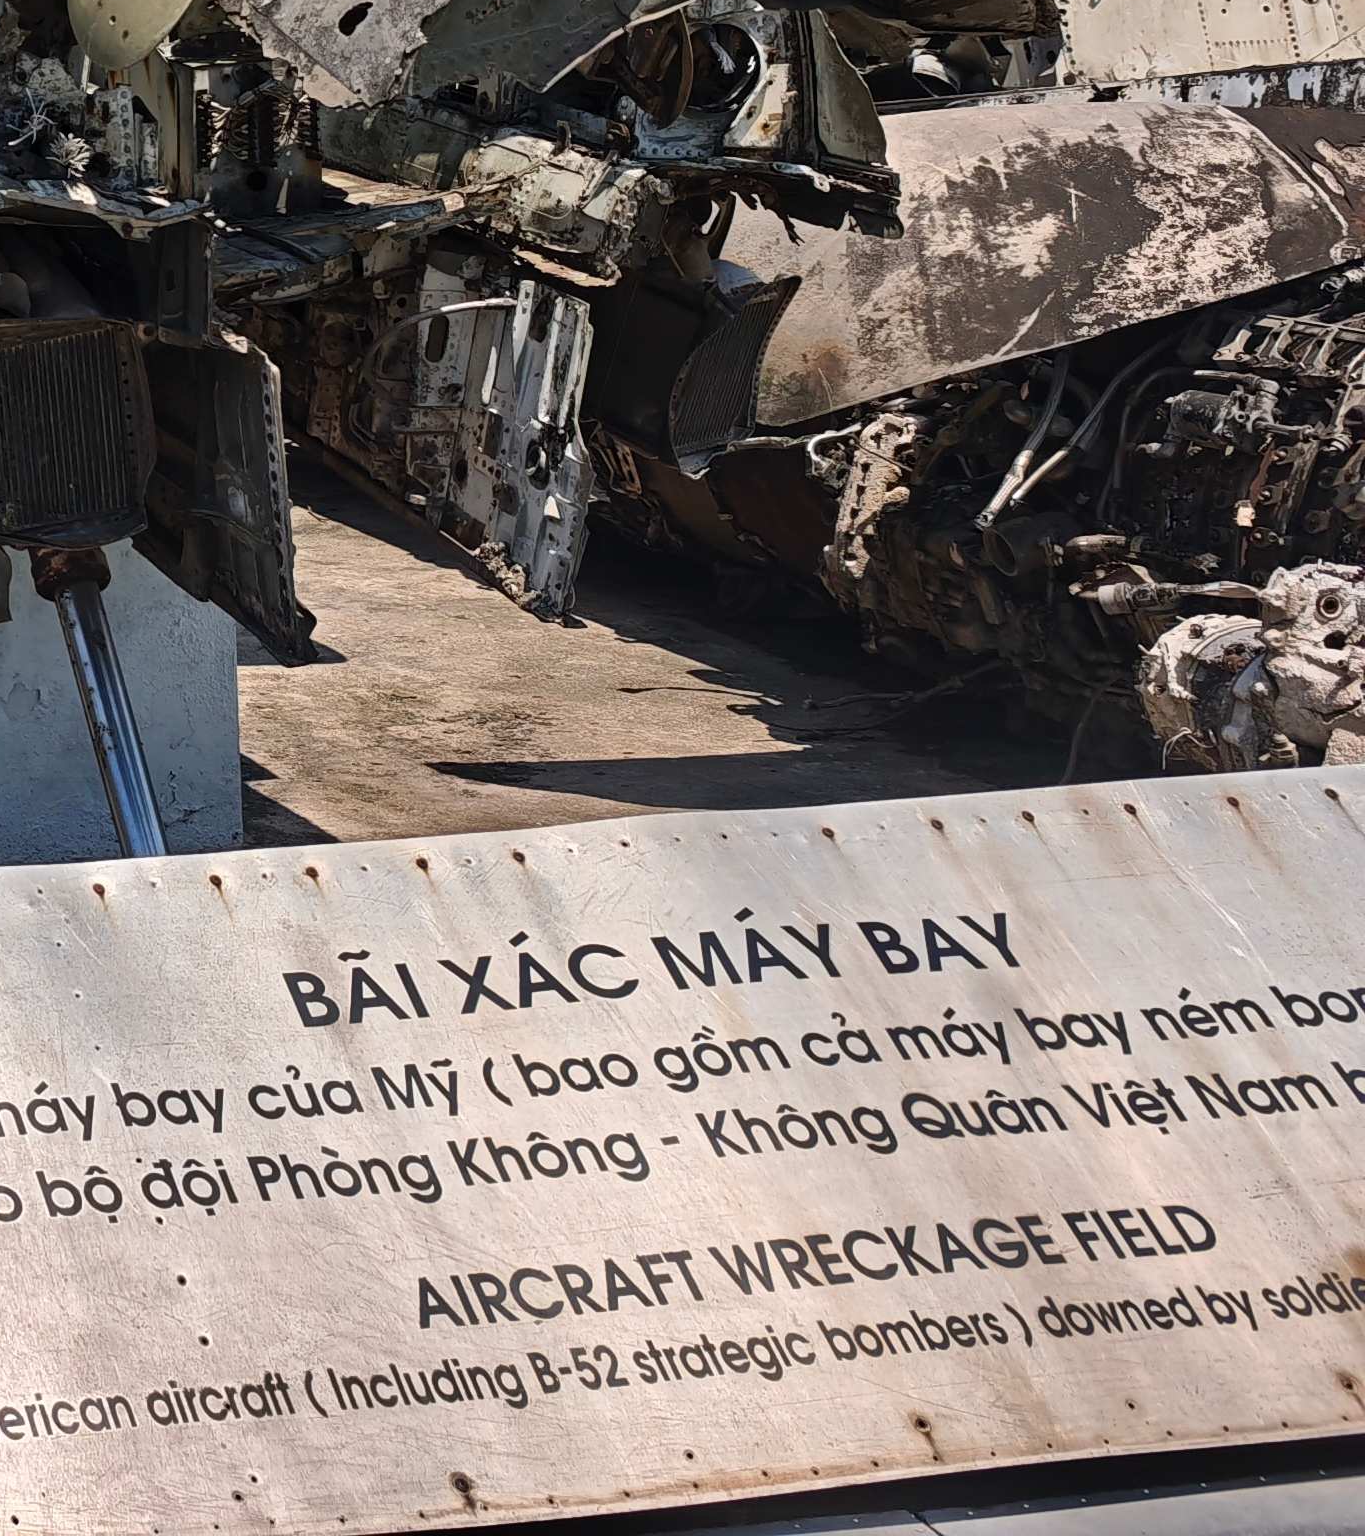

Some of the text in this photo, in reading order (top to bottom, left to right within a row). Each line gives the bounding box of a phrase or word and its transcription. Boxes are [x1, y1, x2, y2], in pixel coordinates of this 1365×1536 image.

[283, 907, 1020, 1027] BÃI XÁC MÁY BAY
[111, 1083, 224, 1133] bay
[248, 1065, 364, 1119] của
[371, 1058, 458, 1116] Mỹ
[654, 1026, 791, 1093] gồm
[801, 1012, 882, 1066] cả
[885, 1008, 1010, 1064] máy
[1013, 1008, 1131, 1054] bay
[1140, 988, 1275, 1040] ném
[1269, 986, 1365, 1027] bo
[36, 1166, 122, 1223] bộ
[141, 1157, 238, 1216] đội
[247, 1147, 442, 1203] Phòng
[447, 1132, 650, 1186] Không
[696, 1104, 898, 1157] Không
[901, 1090, 1068, 1138] Quân
[1061, 1078, 1187, 1135] Việt
[1185, 1073, 1338, 1118] Nam
[418, 1206, 1216, 1329] AIRCRAFT WRECKAGE FIELD
[146, 1371, 295, 1426] aircraft
[527, 1345, 629, 1394] B-52
[633, 1333, 816, 1384] strategic
[1038, 1287, 1203, 1338] downed
[1195, 1285, 1258, 1331] by
